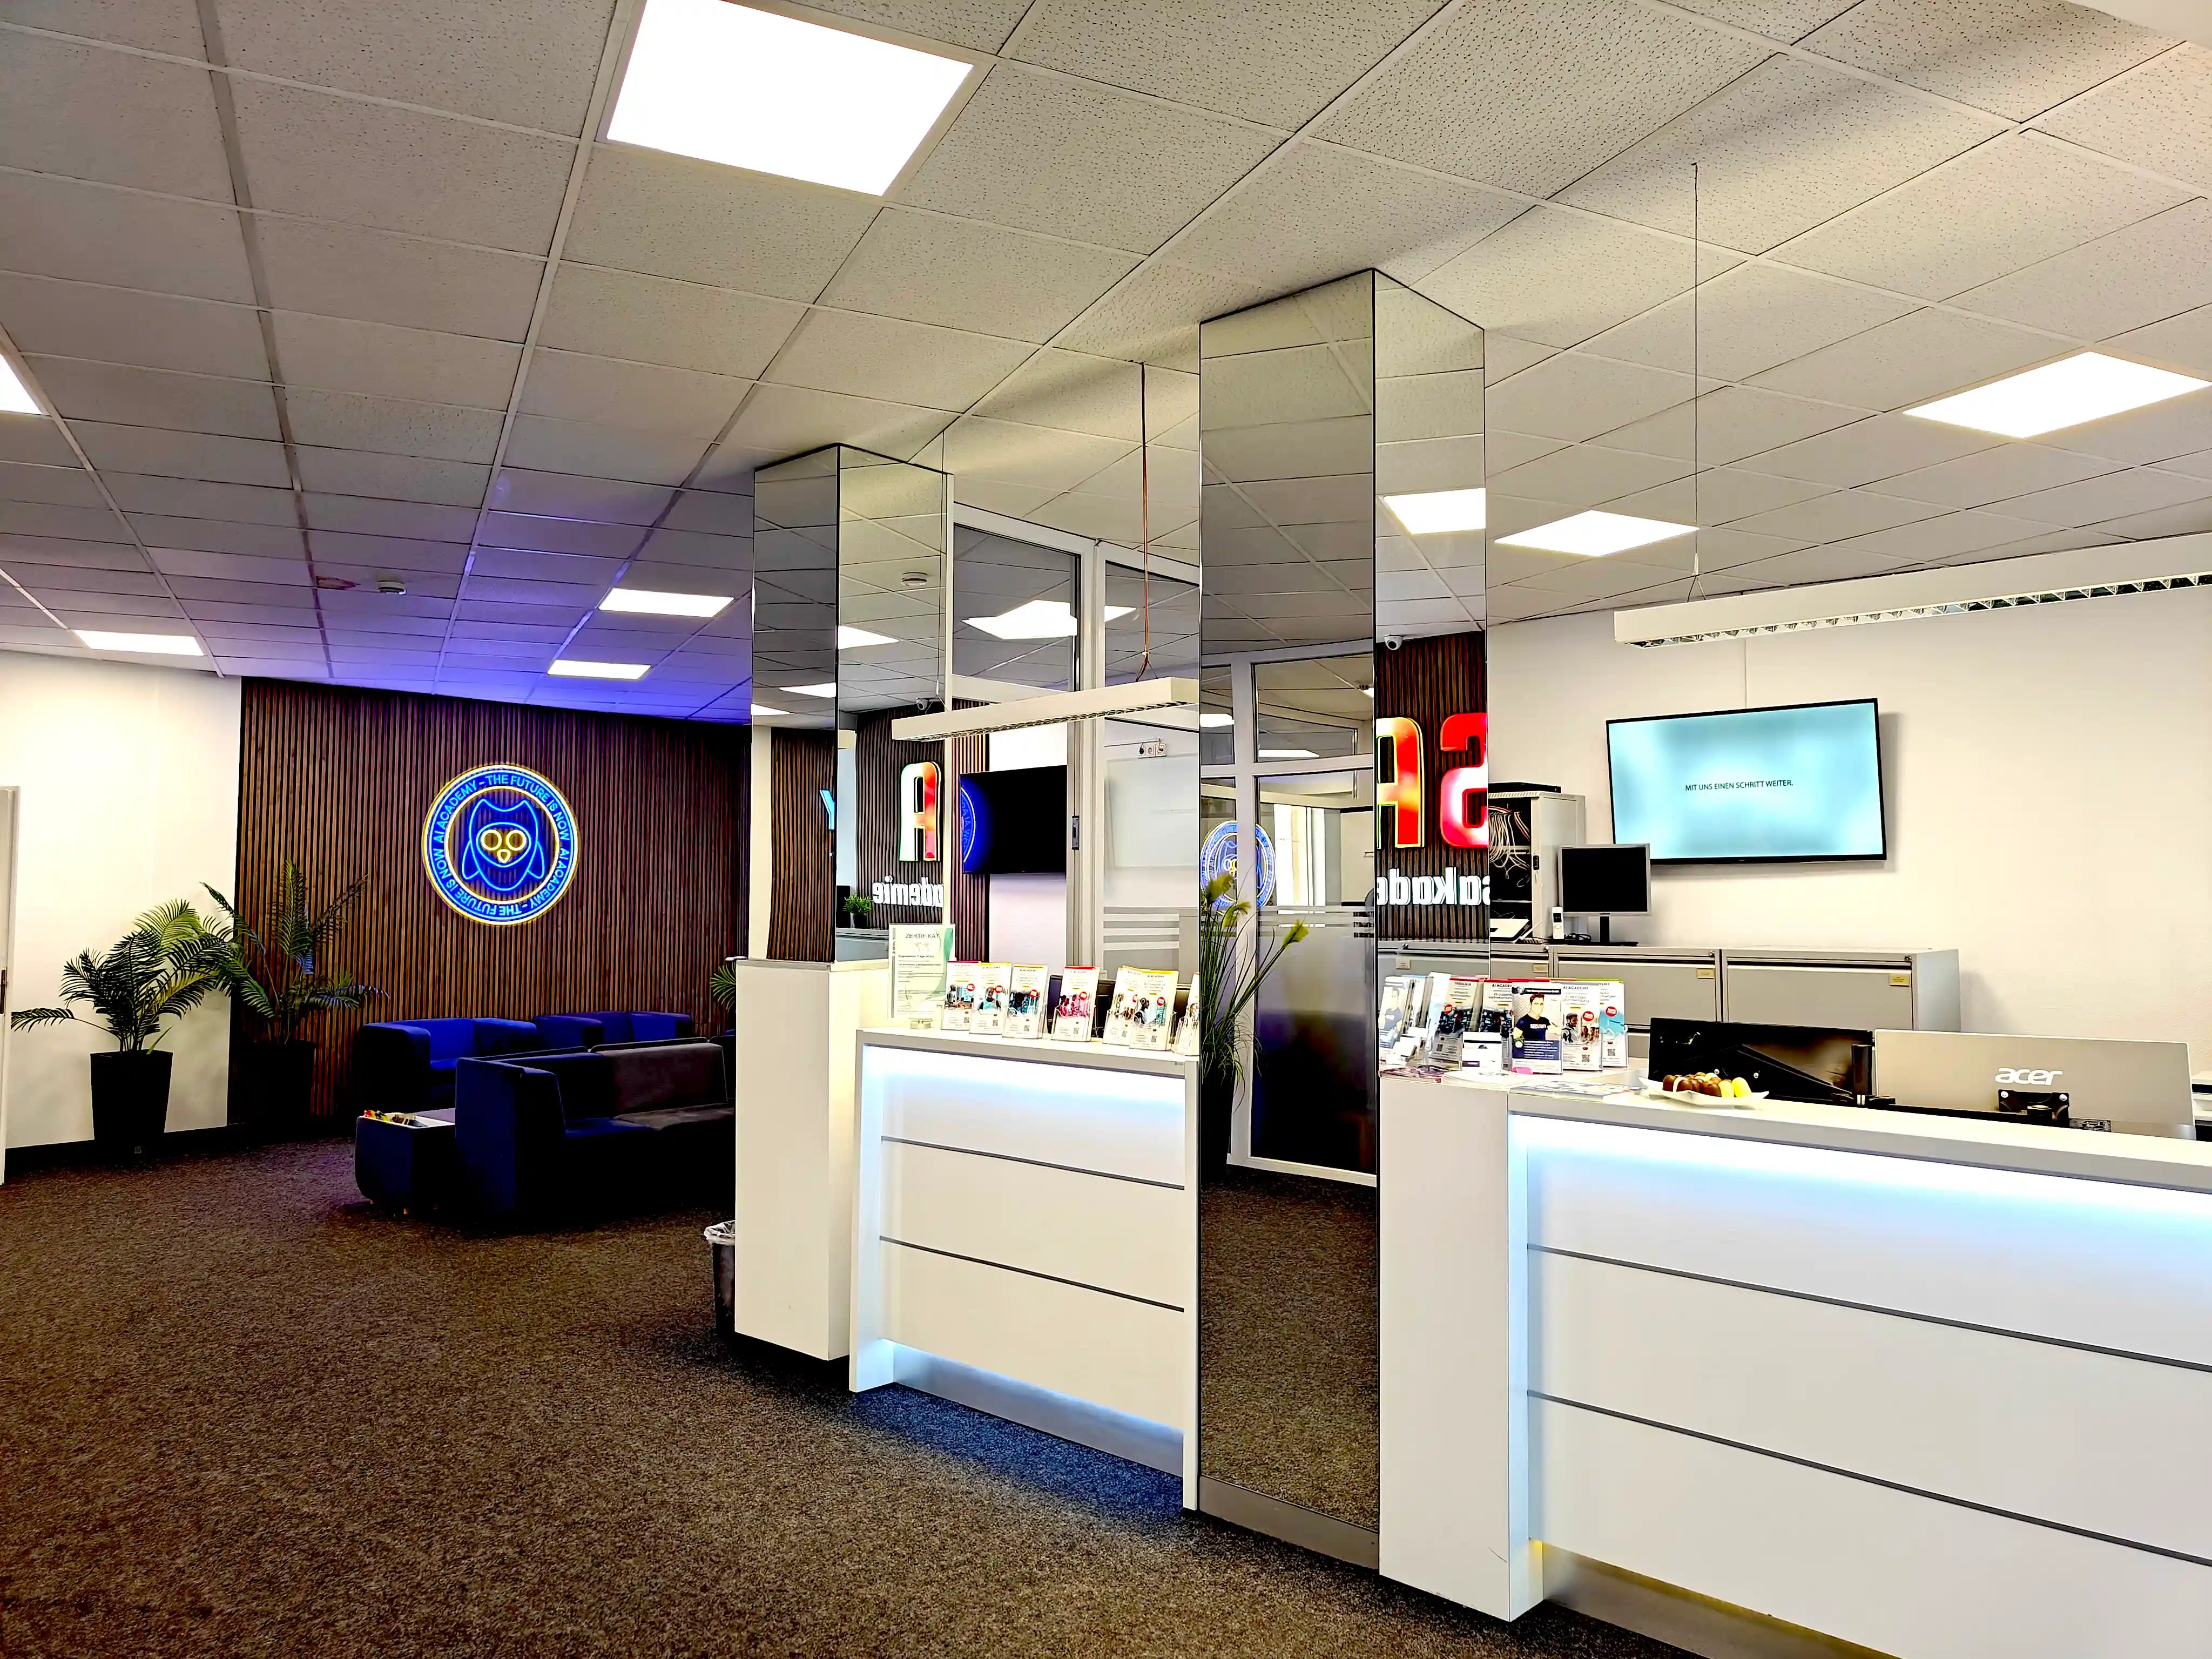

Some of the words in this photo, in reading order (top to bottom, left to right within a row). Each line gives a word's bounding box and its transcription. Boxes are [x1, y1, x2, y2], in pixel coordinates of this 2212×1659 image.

[485, 774, 509, 786] THE
[1765, 779, 1793, 787] WEITER.
[510, 775, 550, 802] FUTURE
[436, 780, 477, 830] ACADEMY
[547, 799, 558, 812] IS
[552, 811, 570, 841] NOW
[434, 830, 445, 843] AI
[433, 848, 452, 880] NOW
[446, 879, 459, 892] IS
[454, 888, 497, 916] FUTURE
[498, 904, 523, 916] THE
[1995, 1068, 2063, 1085] acer
